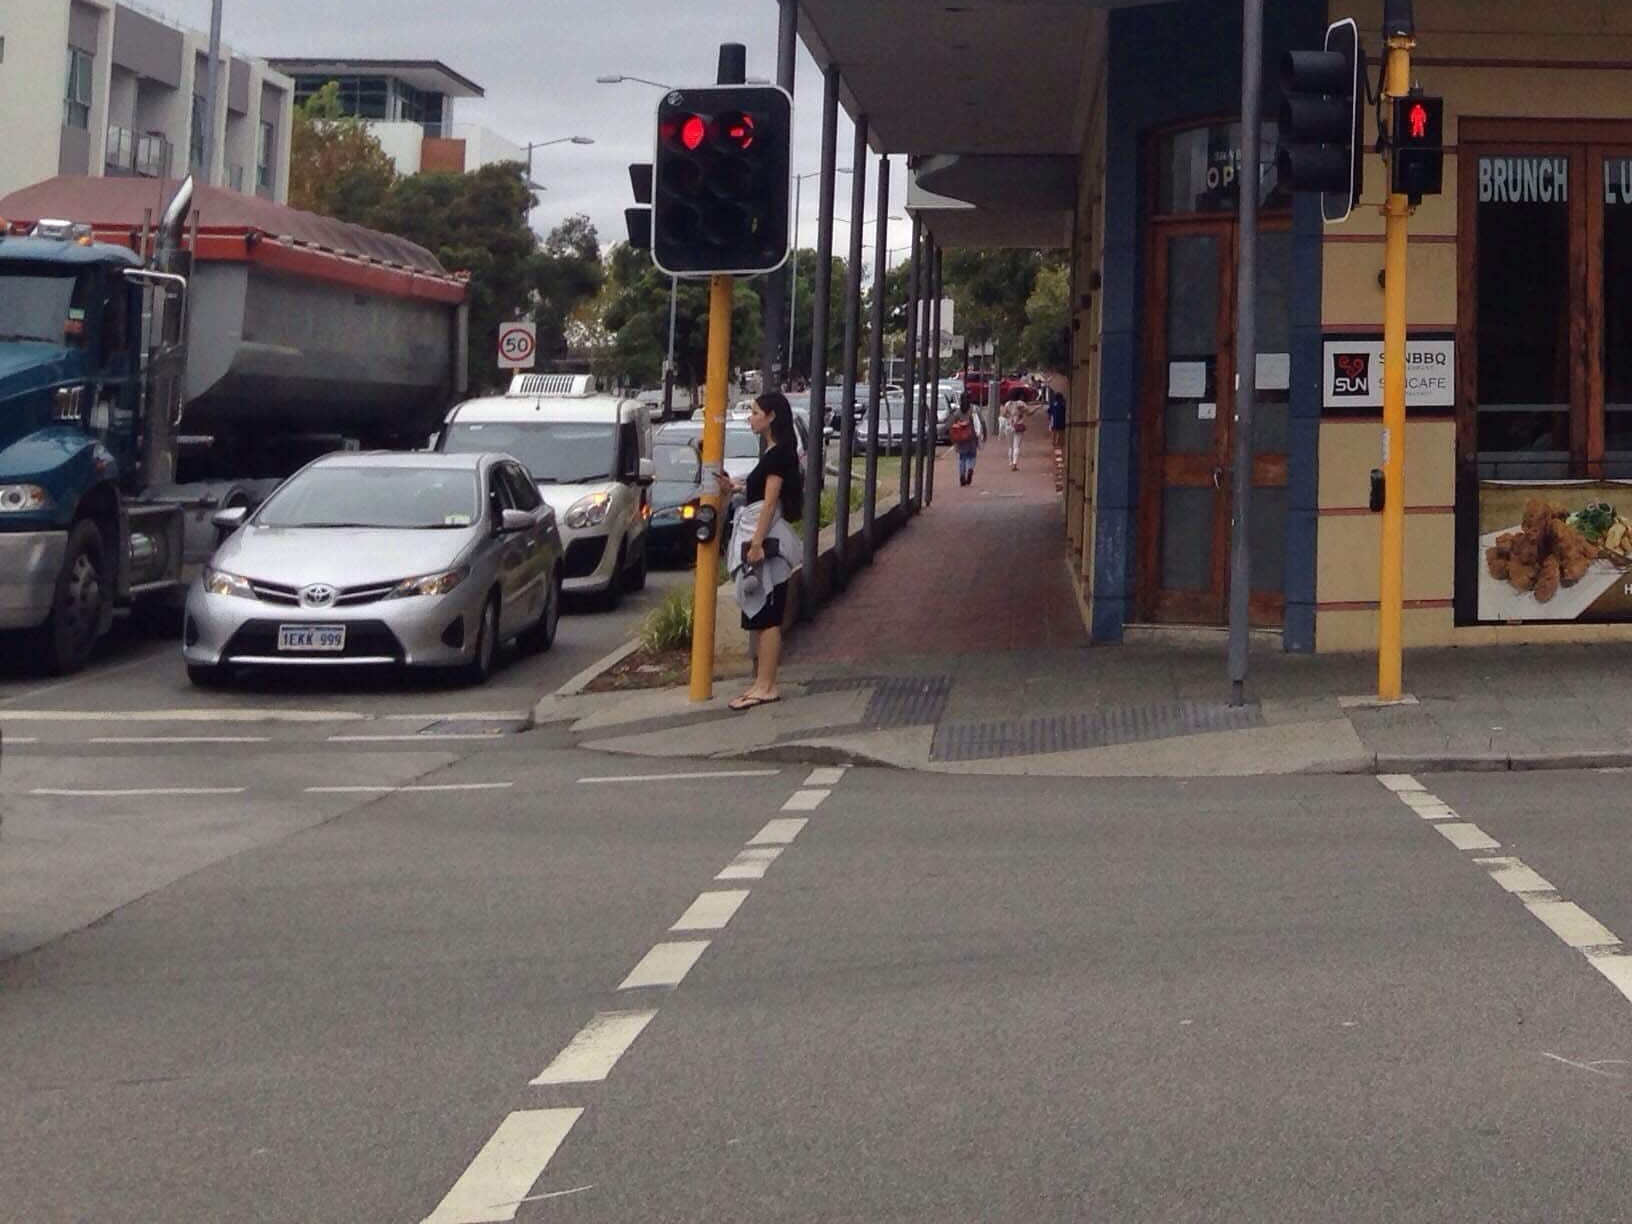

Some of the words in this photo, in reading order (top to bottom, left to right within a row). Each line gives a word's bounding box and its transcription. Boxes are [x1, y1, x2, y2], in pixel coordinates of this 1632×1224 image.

[1478, 158, 1567, 202] BRUNCH
[506, 337, 528, 353] 50
[1335, 377, 1367, 392] SUN
[284, 632, 314, 646] 1EKK
